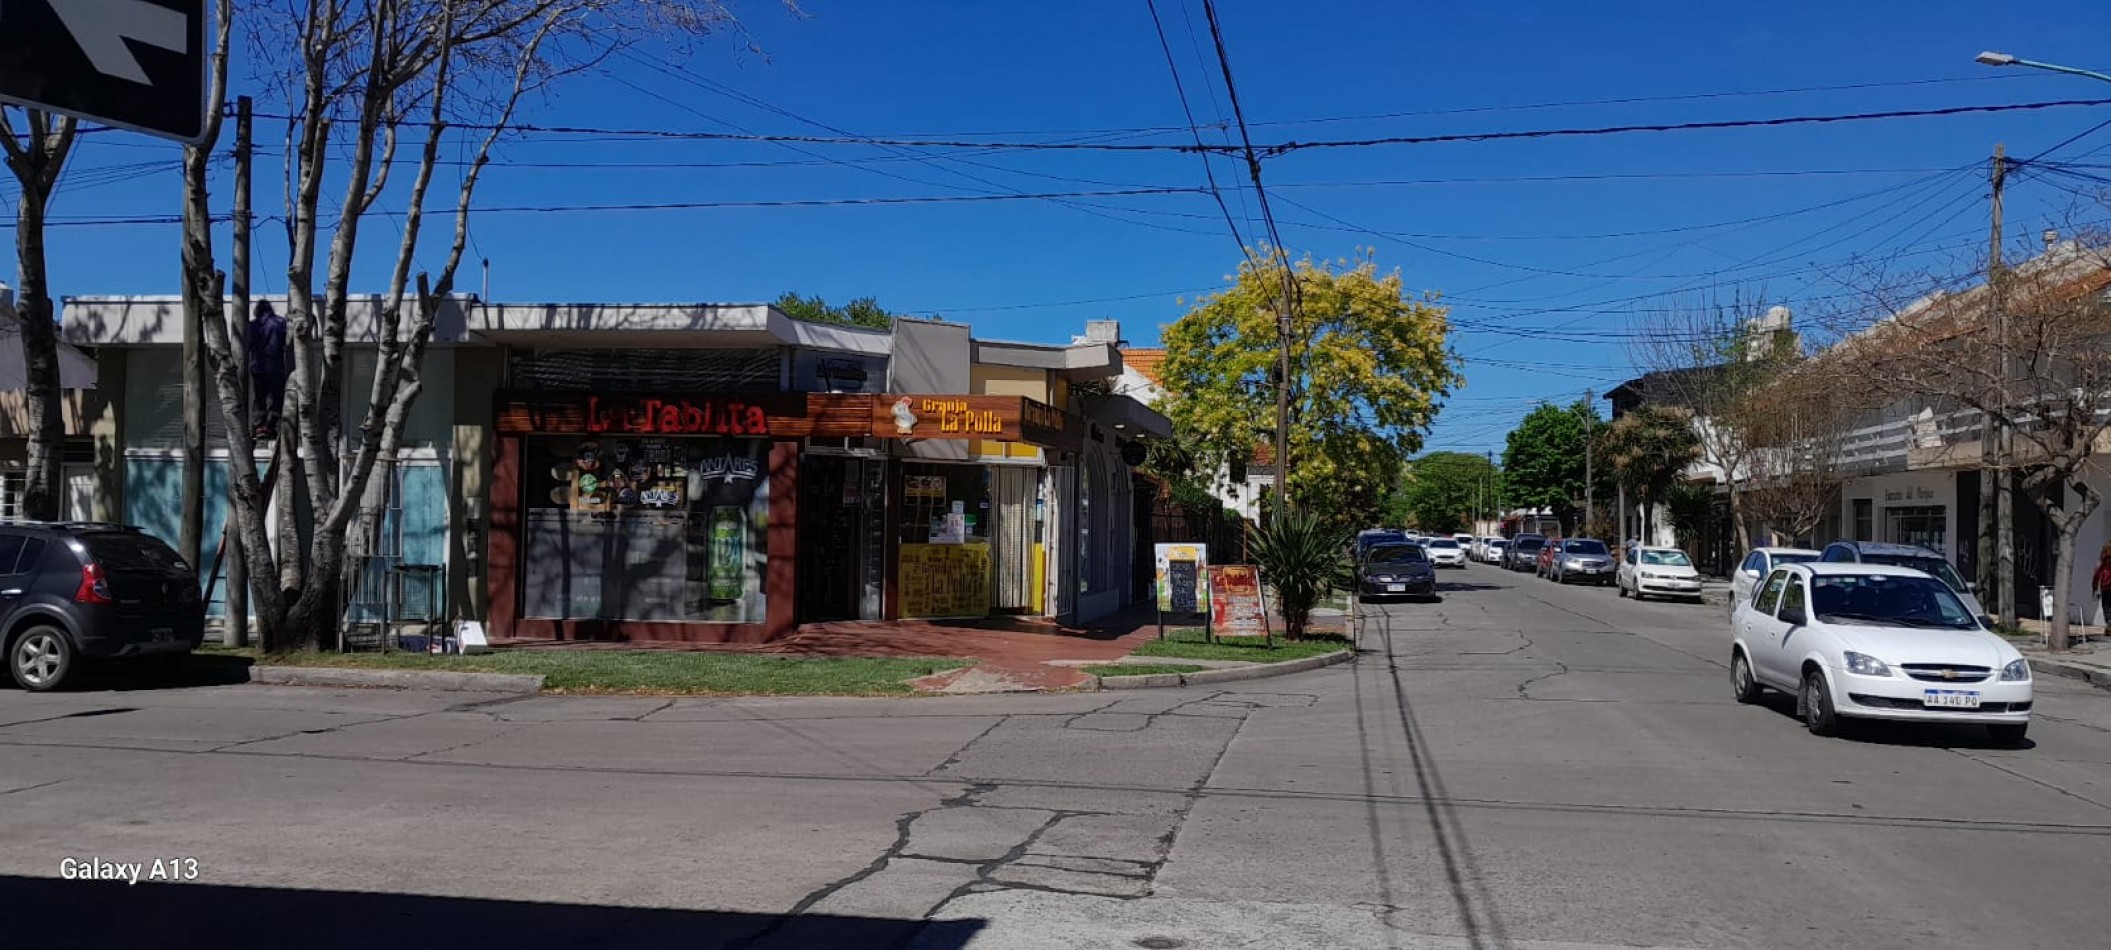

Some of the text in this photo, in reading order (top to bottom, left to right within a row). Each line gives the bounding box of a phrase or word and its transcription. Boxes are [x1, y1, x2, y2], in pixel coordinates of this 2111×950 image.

[640, 399, 769, 433] Tablita
[922, 399, 968, 413] Granja
[941, 412, 959, 433] La
[965, 410, 1002, 433] Polla
[700, 451, 759, 477] ANTARES
